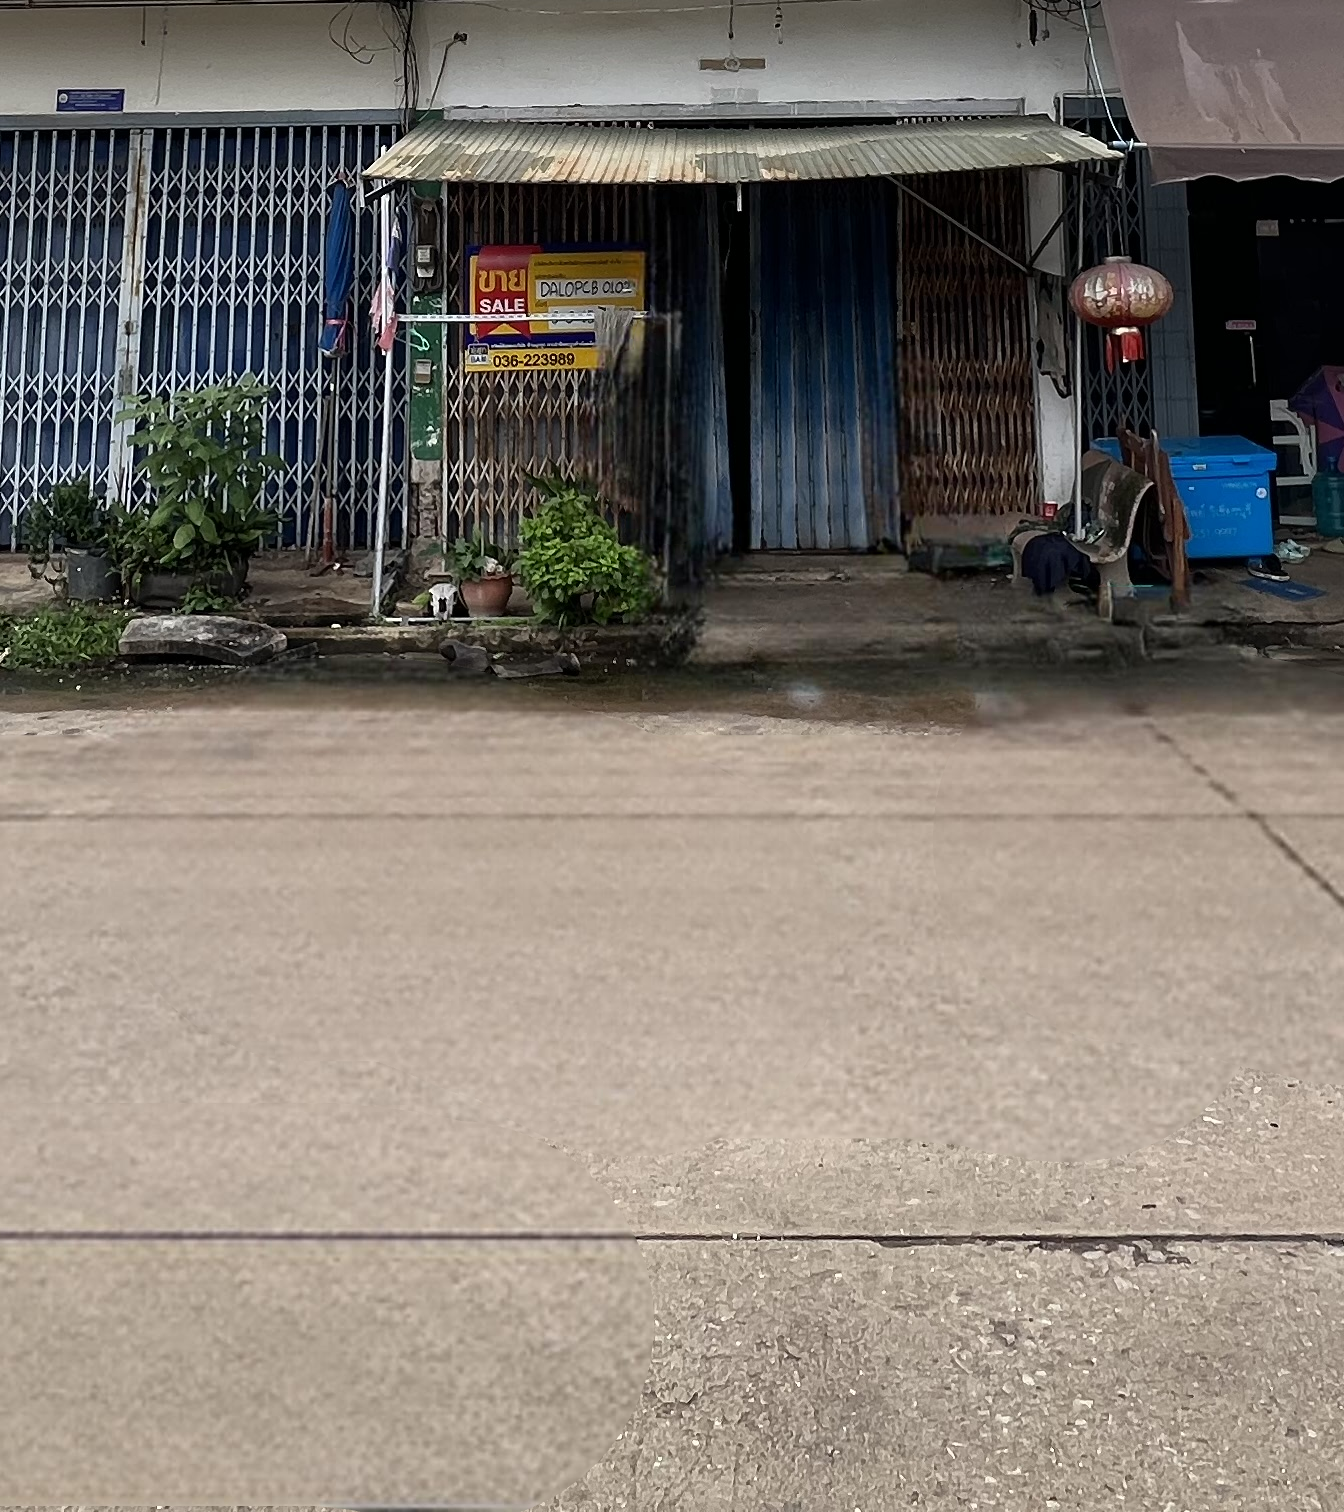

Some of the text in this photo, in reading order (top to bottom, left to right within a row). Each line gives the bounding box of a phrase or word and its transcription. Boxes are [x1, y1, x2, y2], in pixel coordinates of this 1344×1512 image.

[478, 269, 526, 293] ขาย
[479, 298, 525, 313] SALE
[492, 352, 575, 368] 036-223989
